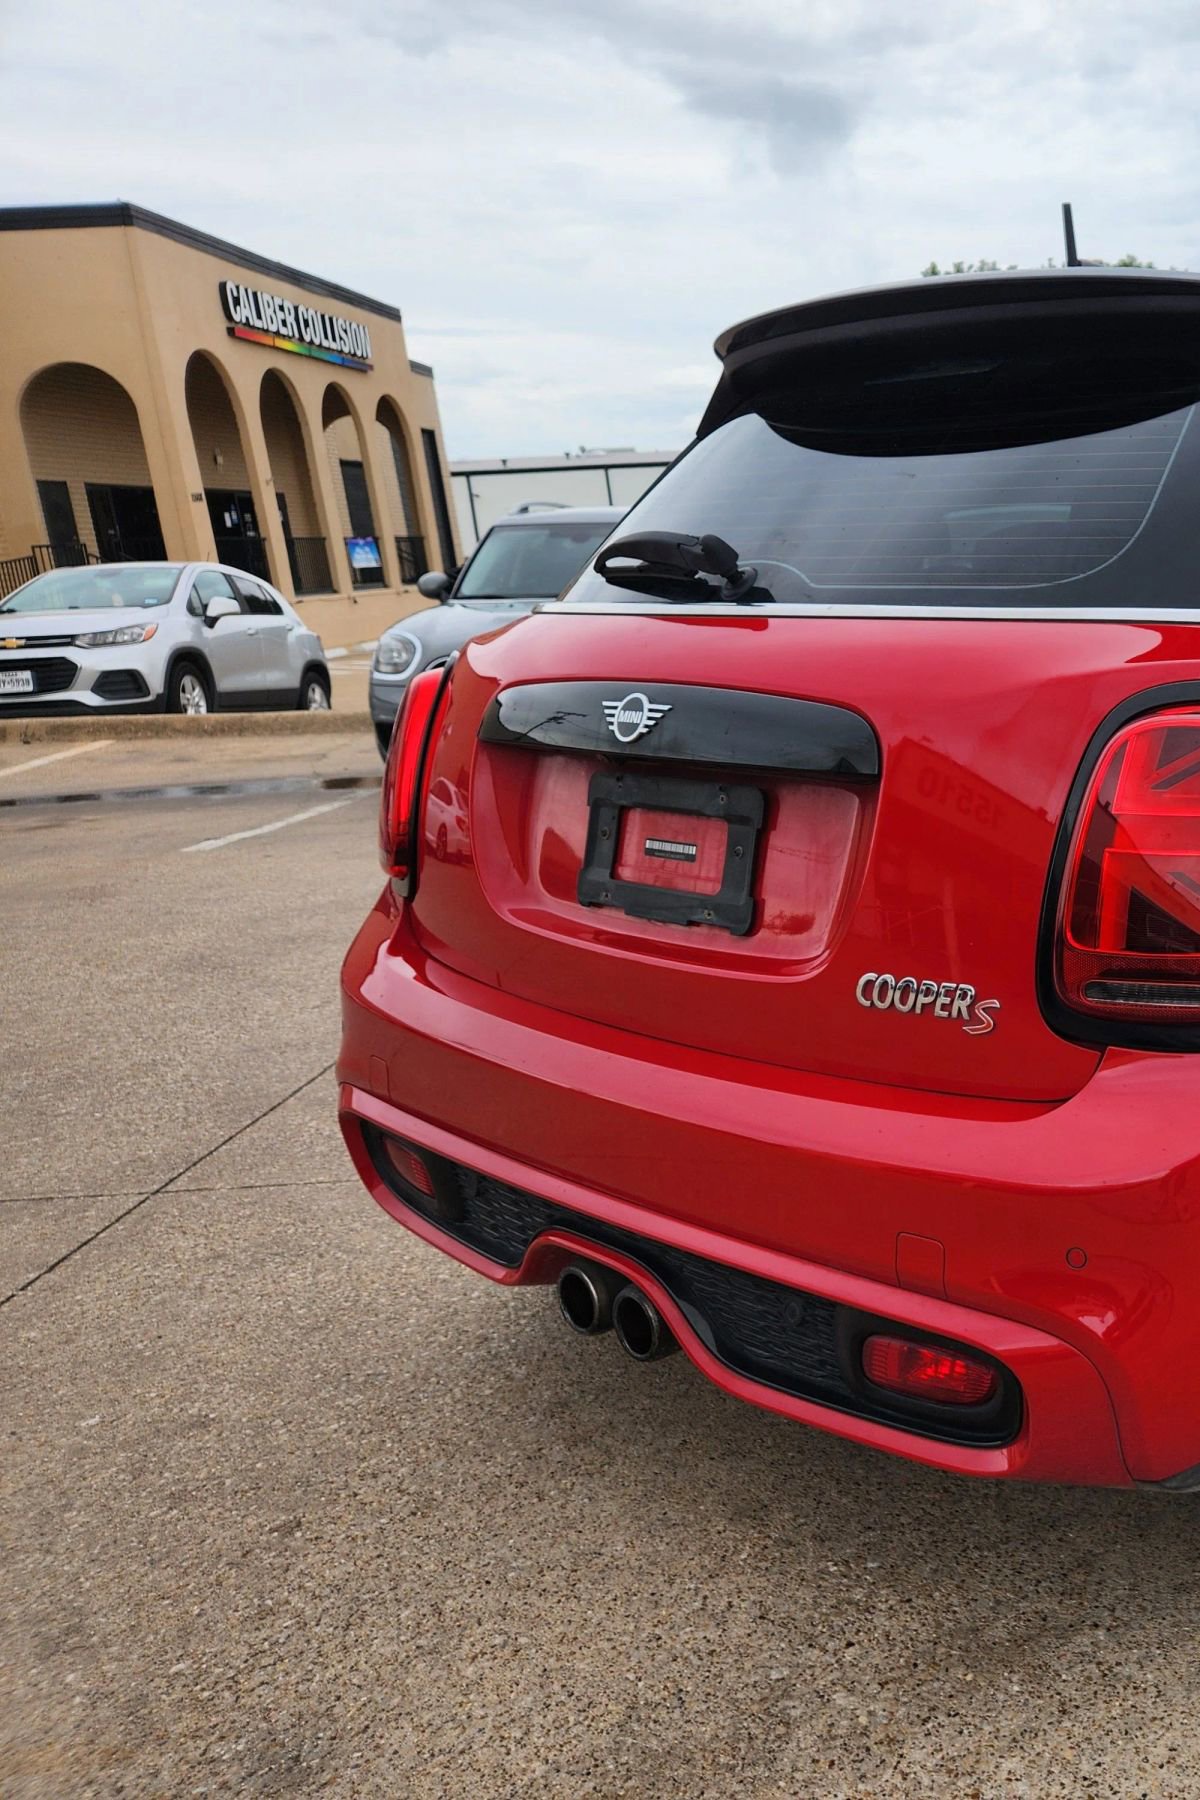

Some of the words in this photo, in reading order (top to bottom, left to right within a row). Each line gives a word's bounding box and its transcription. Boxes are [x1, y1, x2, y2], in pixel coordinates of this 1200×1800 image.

[225, 280, 300, 339] CALIBER
[298, 304, 371, 359] COLLISION
[618, 710, 643, 724] MINI
[855, 972, 975, 1020] COOPER
[962, 999, 1001, 1034] S
